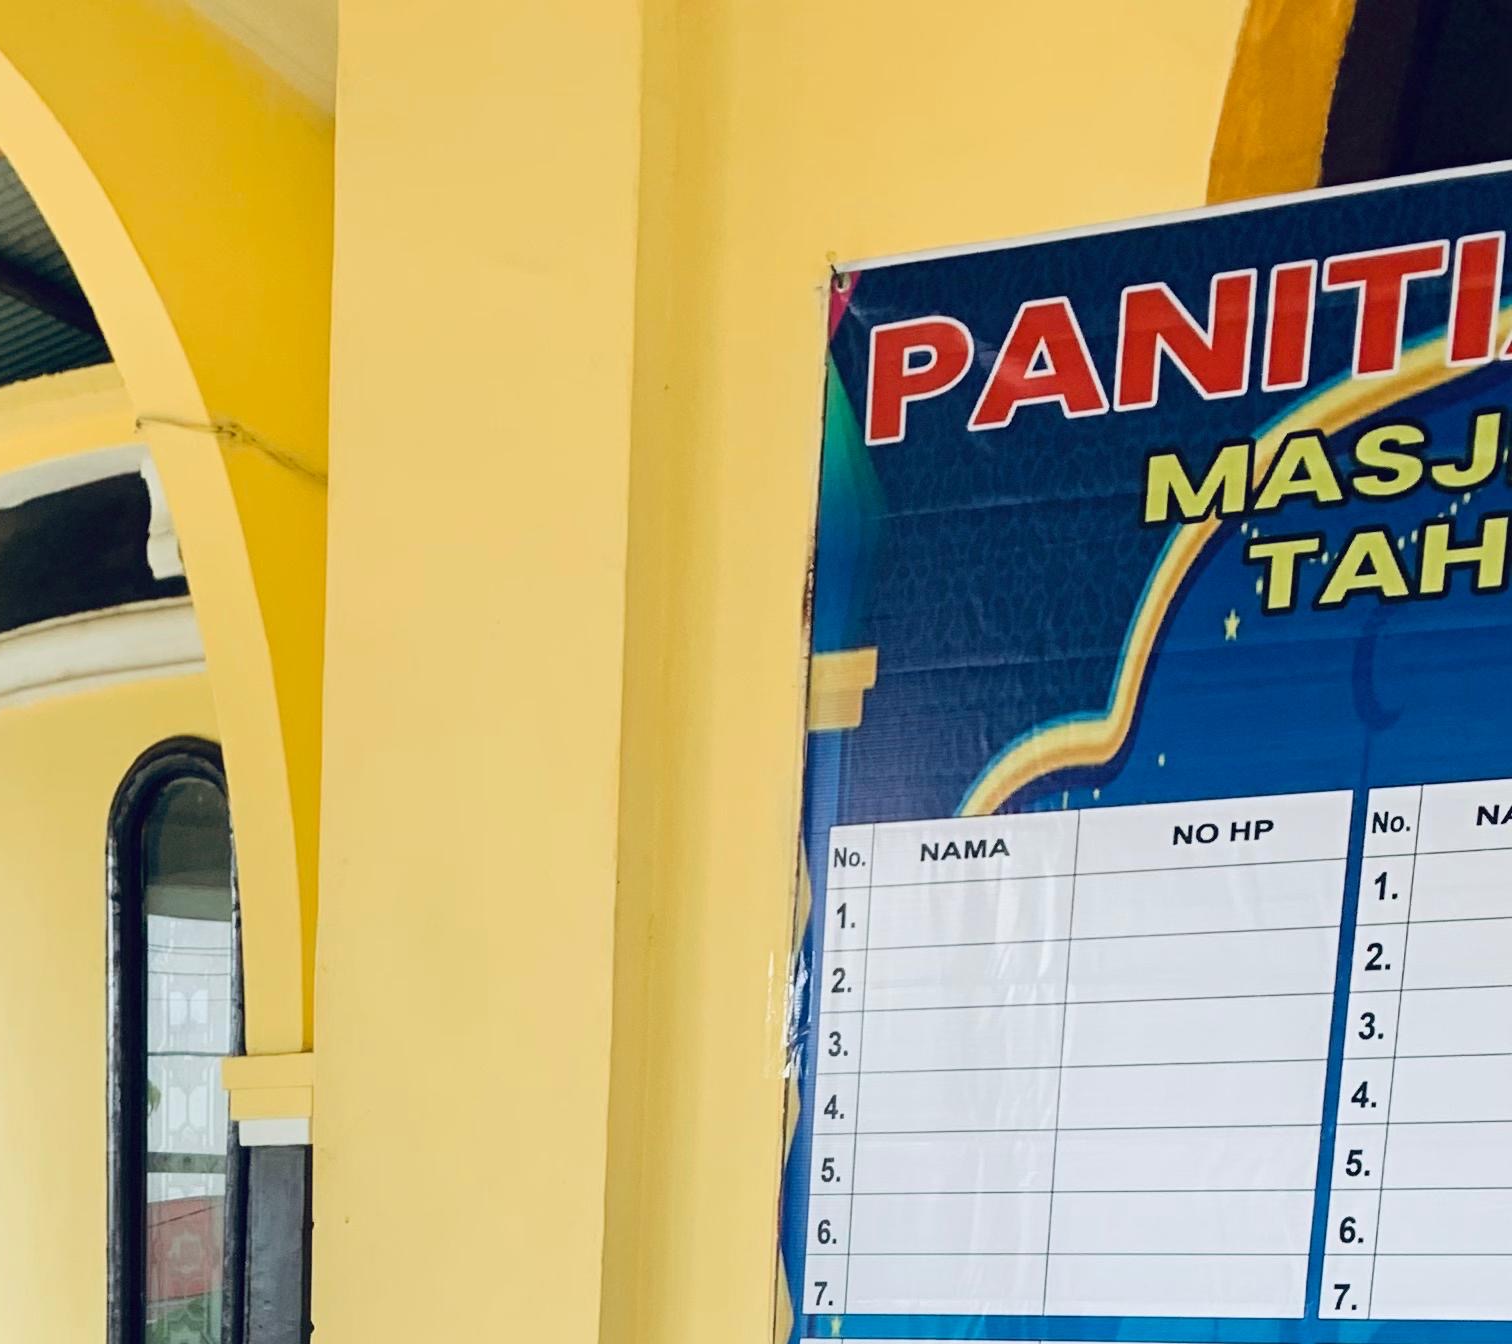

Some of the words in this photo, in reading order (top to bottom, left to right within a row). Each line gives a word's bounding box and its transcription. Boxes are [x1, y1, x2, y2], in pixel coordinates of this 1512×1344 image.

[865, 231, 1512, 446] PANITI
[1142, 410, 1506, 524] MASJ
[1248, 516, 1510, 612] TAH
[1371, 811, 1411, 834] No.
[833, 847, 866, 868] No.
[920, 838, 1010, 862] NAMA
[1172, 823, 1219, 846] NO
[1229, 819, 1275, 842] HP
[1374, 871, 1398, 901] 1.
[836, 902, 855, 929] 1.
[1364, 942, 1391, 972] 2.
[831, 967, 852, 994] 2.
[1358, 1011, 1384, 1041] 3.
[828, 1031, 849, 1057] 3.
[823, 1094, 845, 1120] 4.
[1350, 1080, 1377, 1109] 4.
[821, 1157, 841, 1183] 5.
[1345, 1149, 1370, 1177] 5.
[817, 1219, 837, 1245] 6.
[1339, 1216, 1364, 1244] 6.
[814, 1281, 834, 1306] 7.
[1333, 1283, 1357, 1311] 7.
